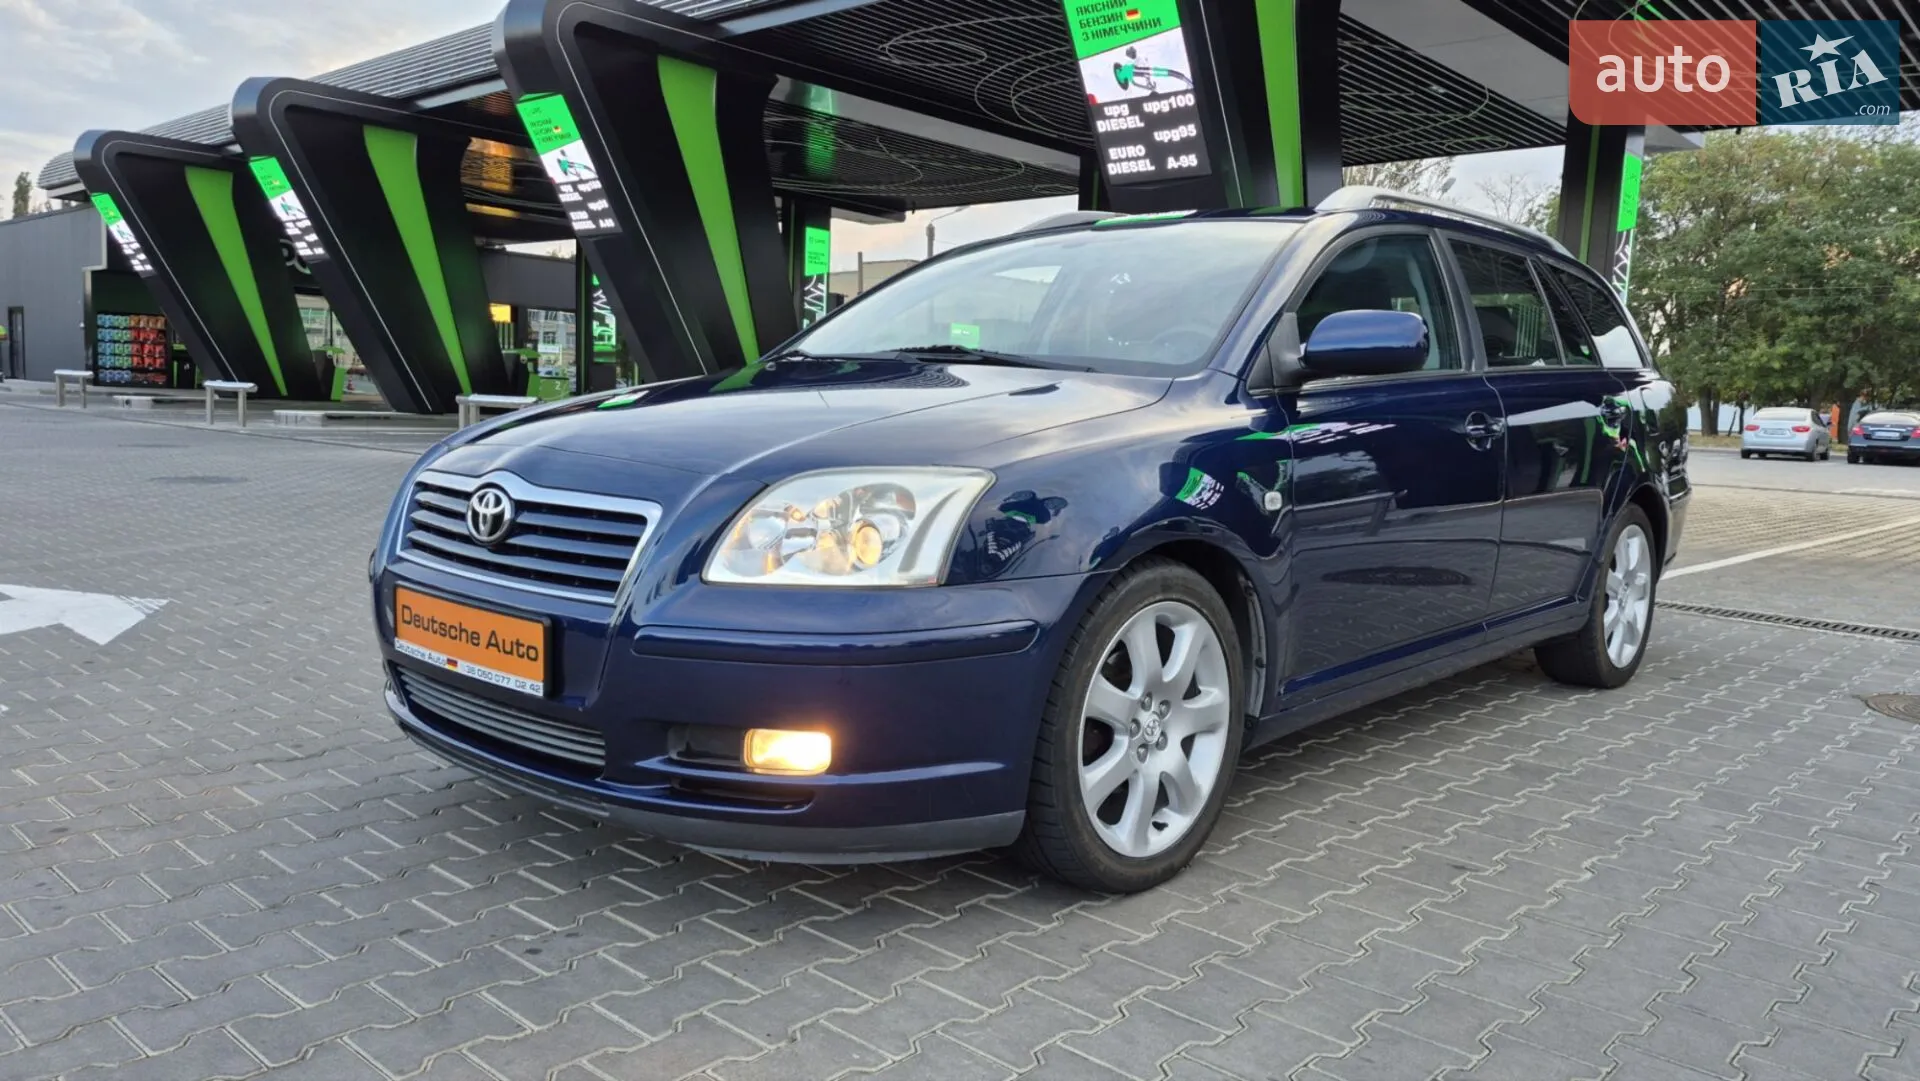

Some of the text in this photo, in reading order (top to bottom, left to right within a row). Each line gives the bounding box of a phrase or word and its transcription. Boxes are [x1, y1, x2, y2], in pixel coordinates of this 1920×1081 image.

[1079, 12, 1123, 29] БЕНЗИН
[1091, 17, 1162, 40] НІМЕЧЧИНИ
[1104, 94, 1194, 117] upg upg100
[1096, 115, 1145, 132] DIESEL
[1154, 124, 1197, 142] upg95
[1108, 145, 1145, 160] EURO
[1107, 154, 1198, 175] DIESEL A-95
[401, 604, 539, 661] Deutsche Auto
